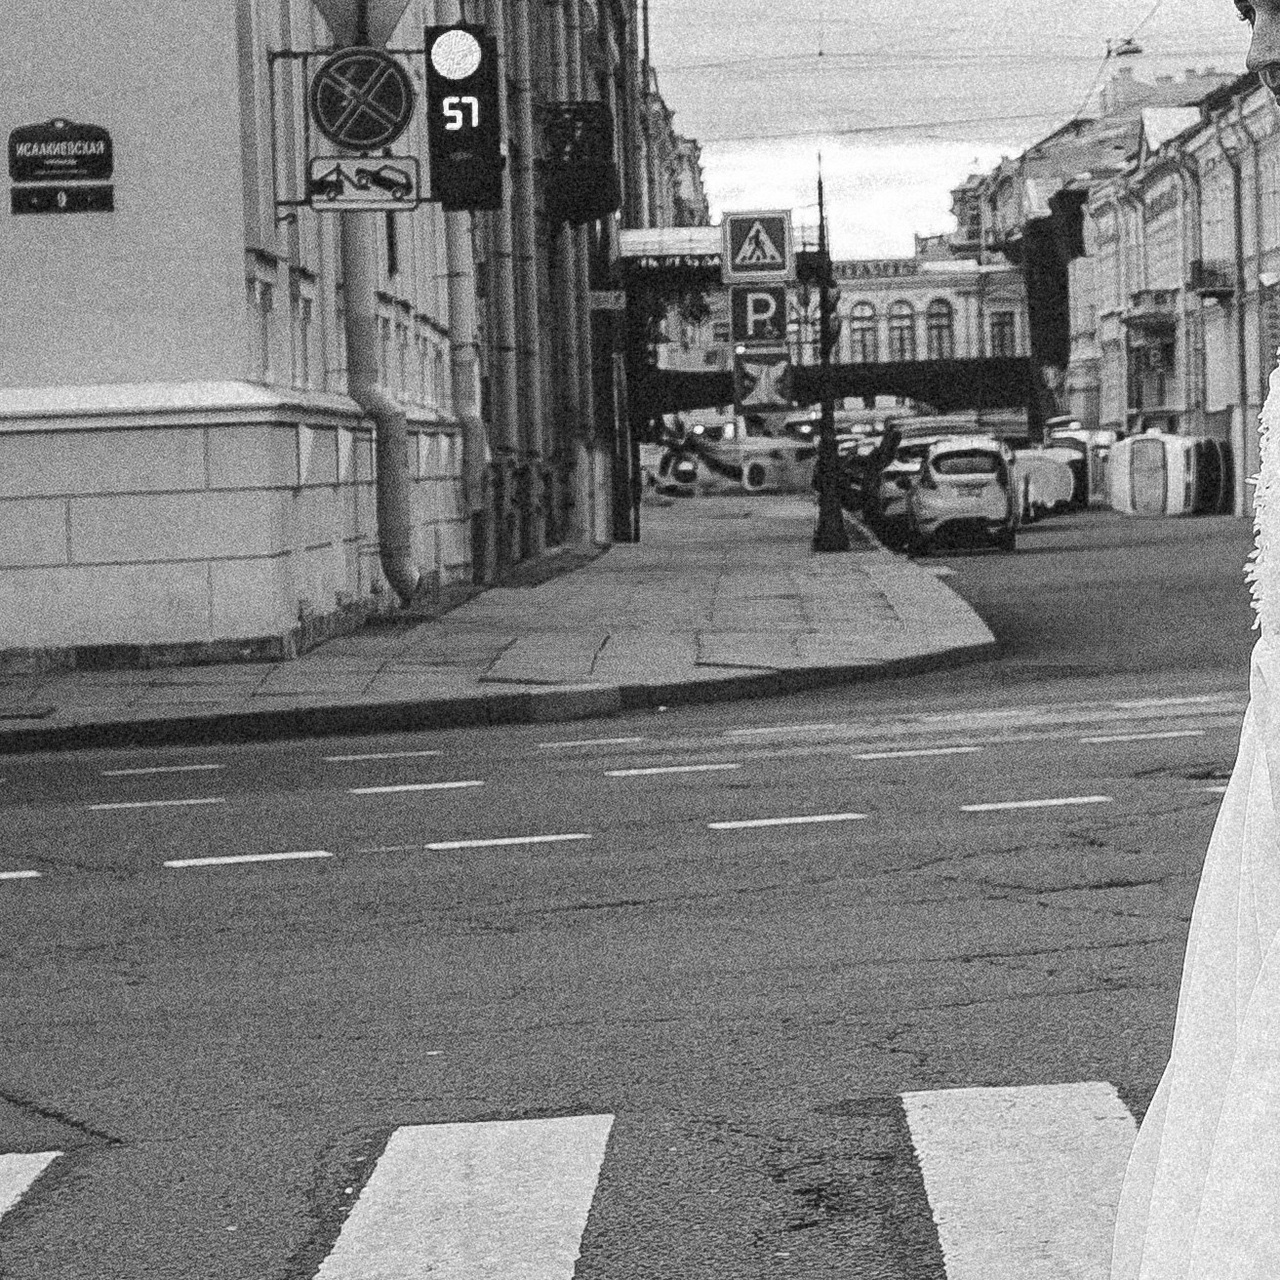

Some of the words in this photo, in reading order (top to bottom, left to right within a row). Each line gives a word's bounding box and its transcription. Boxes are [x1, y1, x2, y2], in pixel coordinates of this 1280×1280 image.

[443, 96, 479, 130] 57
[16, 141, 105, 157] ИСААКИЕВСКАЯ
[747, 292, 777, 335] P
